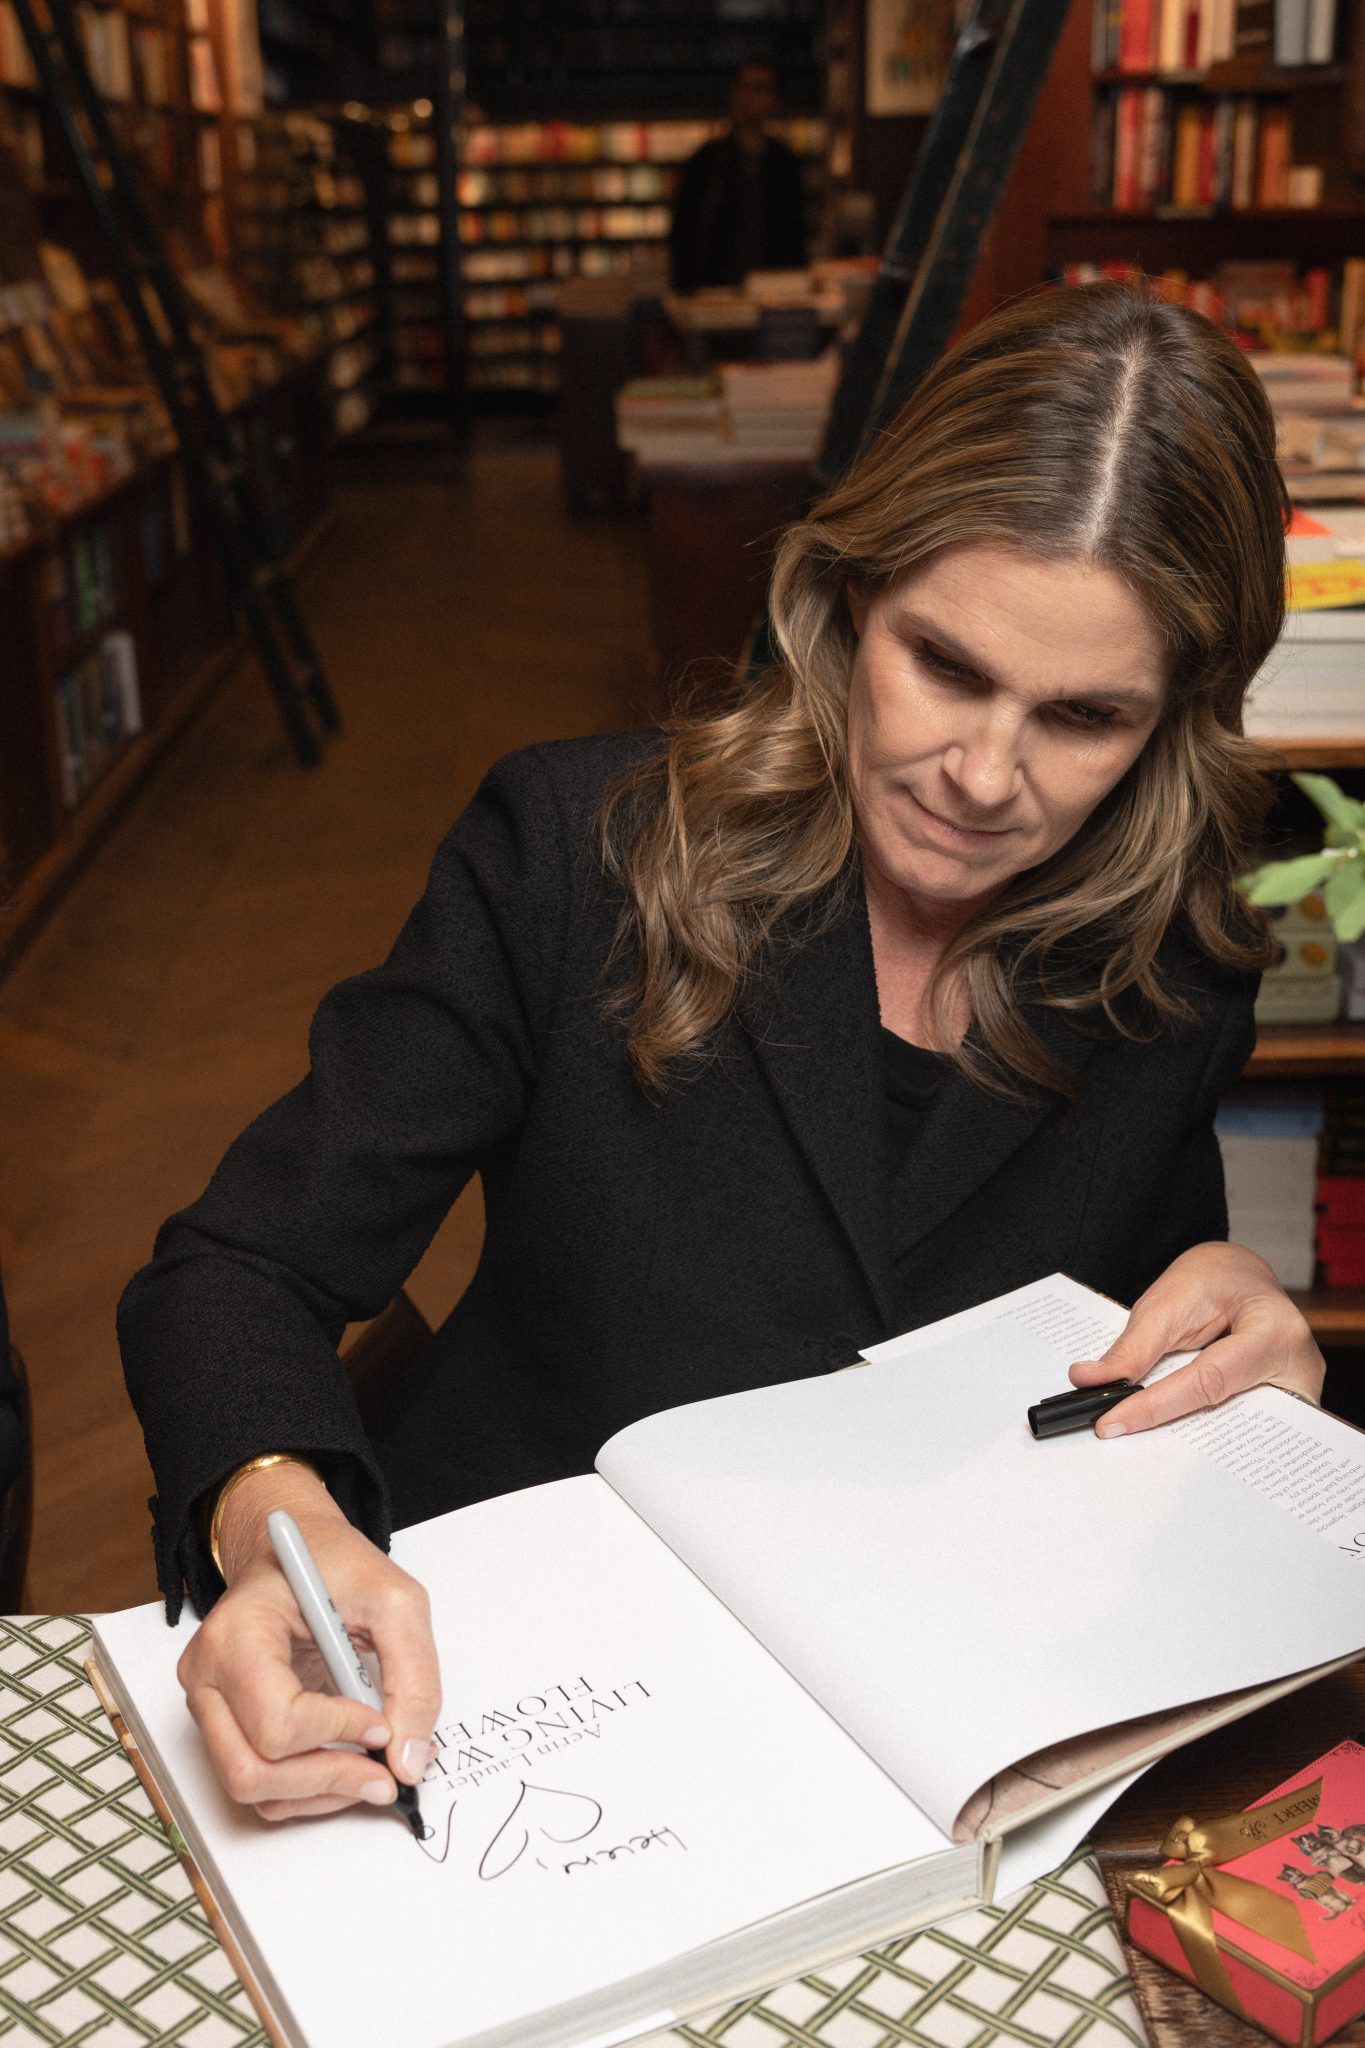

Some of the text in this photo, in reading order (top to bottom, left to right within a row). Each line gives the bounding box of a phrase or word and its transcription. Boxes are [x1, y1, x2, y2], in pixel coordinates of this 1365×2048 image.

[416, 1680, 651, 1786] LIVING WIT
[430, 1676, 594, 1750] FLOWE
[445, 1723, 602, 1792] Aerin Lauder
[1273, 1794, 1320, 1826] MEERT
